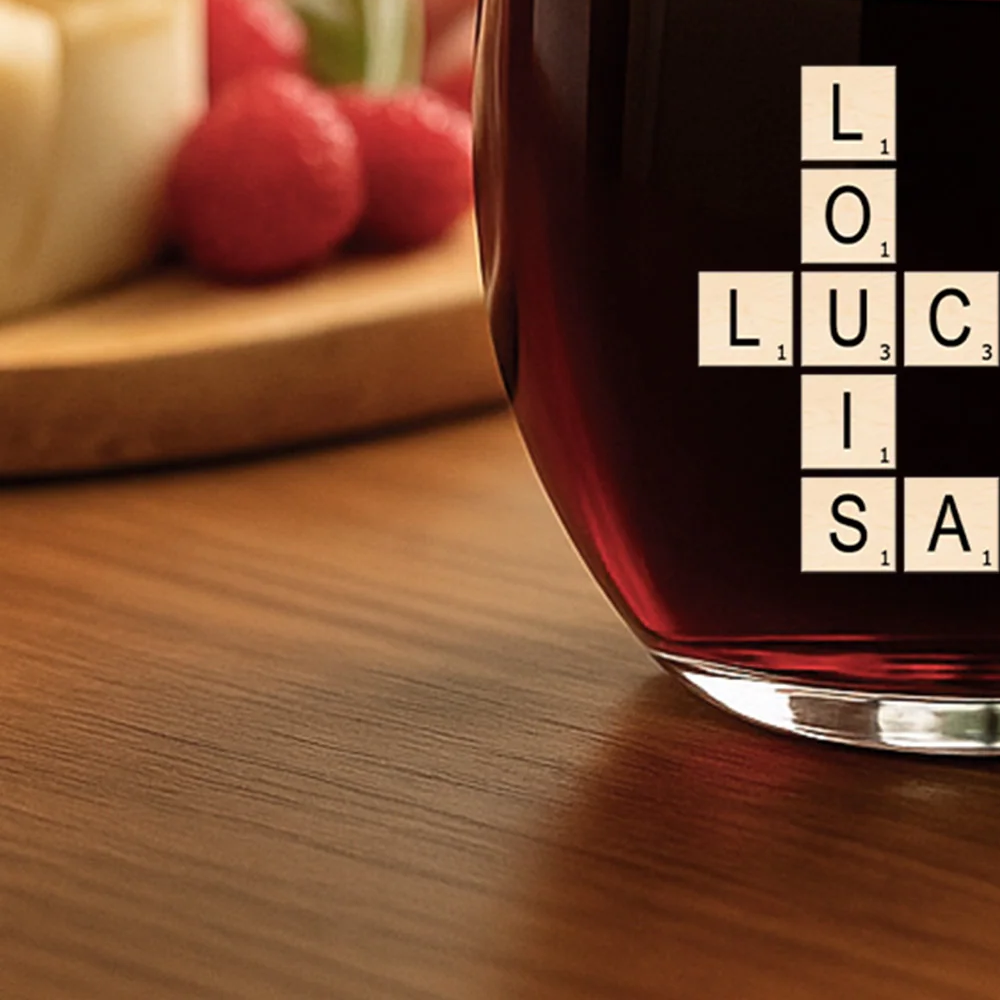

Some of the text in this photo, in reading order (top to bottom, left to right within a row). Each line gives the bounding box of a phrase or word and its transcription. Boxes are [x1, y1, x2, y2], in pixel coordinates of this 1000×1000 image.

[880, 139, 889, 155] 1
[880, 241, 889, 258] 1
[777, 344, 786, 361] 1
[880, 343, 891, 361] 3
[982, 343, 993, 361] 3
[880, 447, 889, 464] 1
[880, 550, 890, 566] 1
[982, 550, 991, 566] 1
